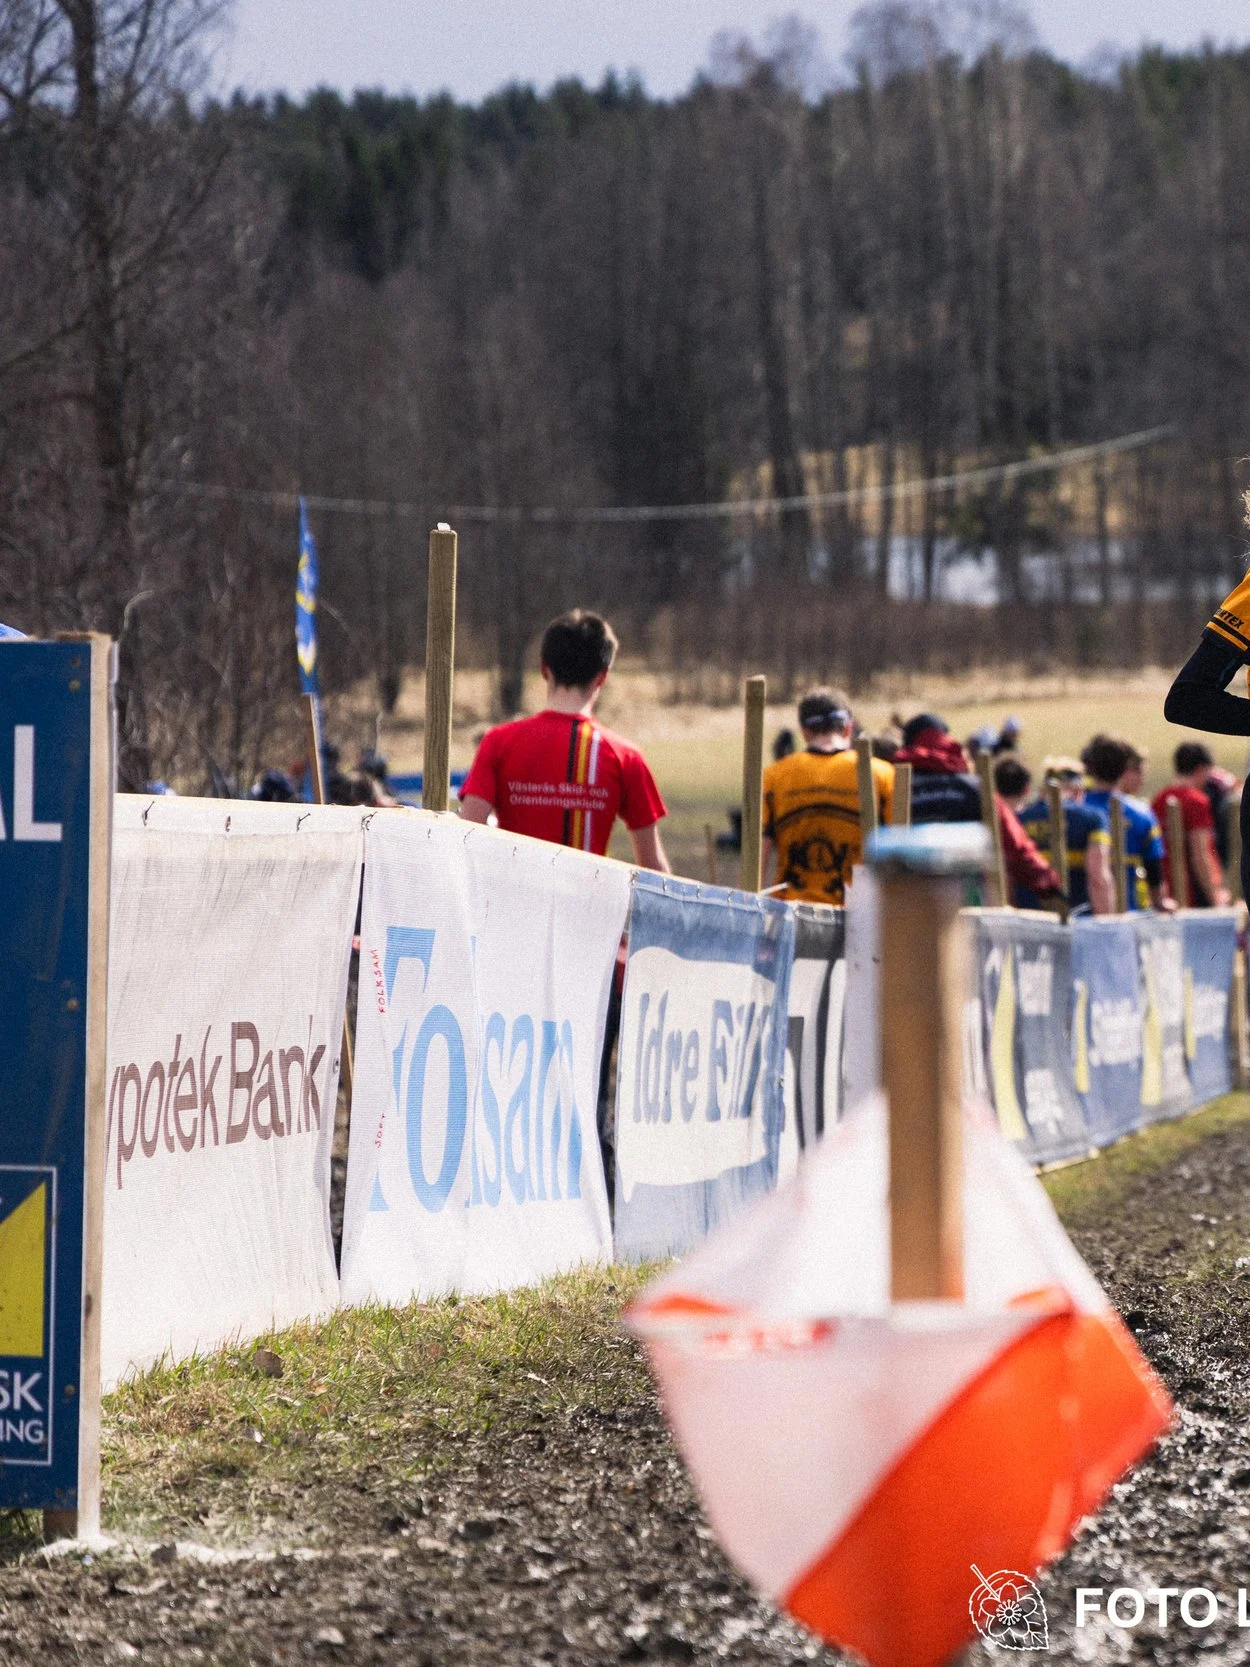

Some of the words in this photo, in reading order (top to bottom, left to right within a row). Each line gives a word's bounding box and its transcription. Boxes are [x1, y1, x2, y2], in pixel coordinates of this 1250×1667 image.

[0, 725, 63, 841] L
[225, 1013, 327, 1145] Bank
[632, 989, 699, 1124] Idre
